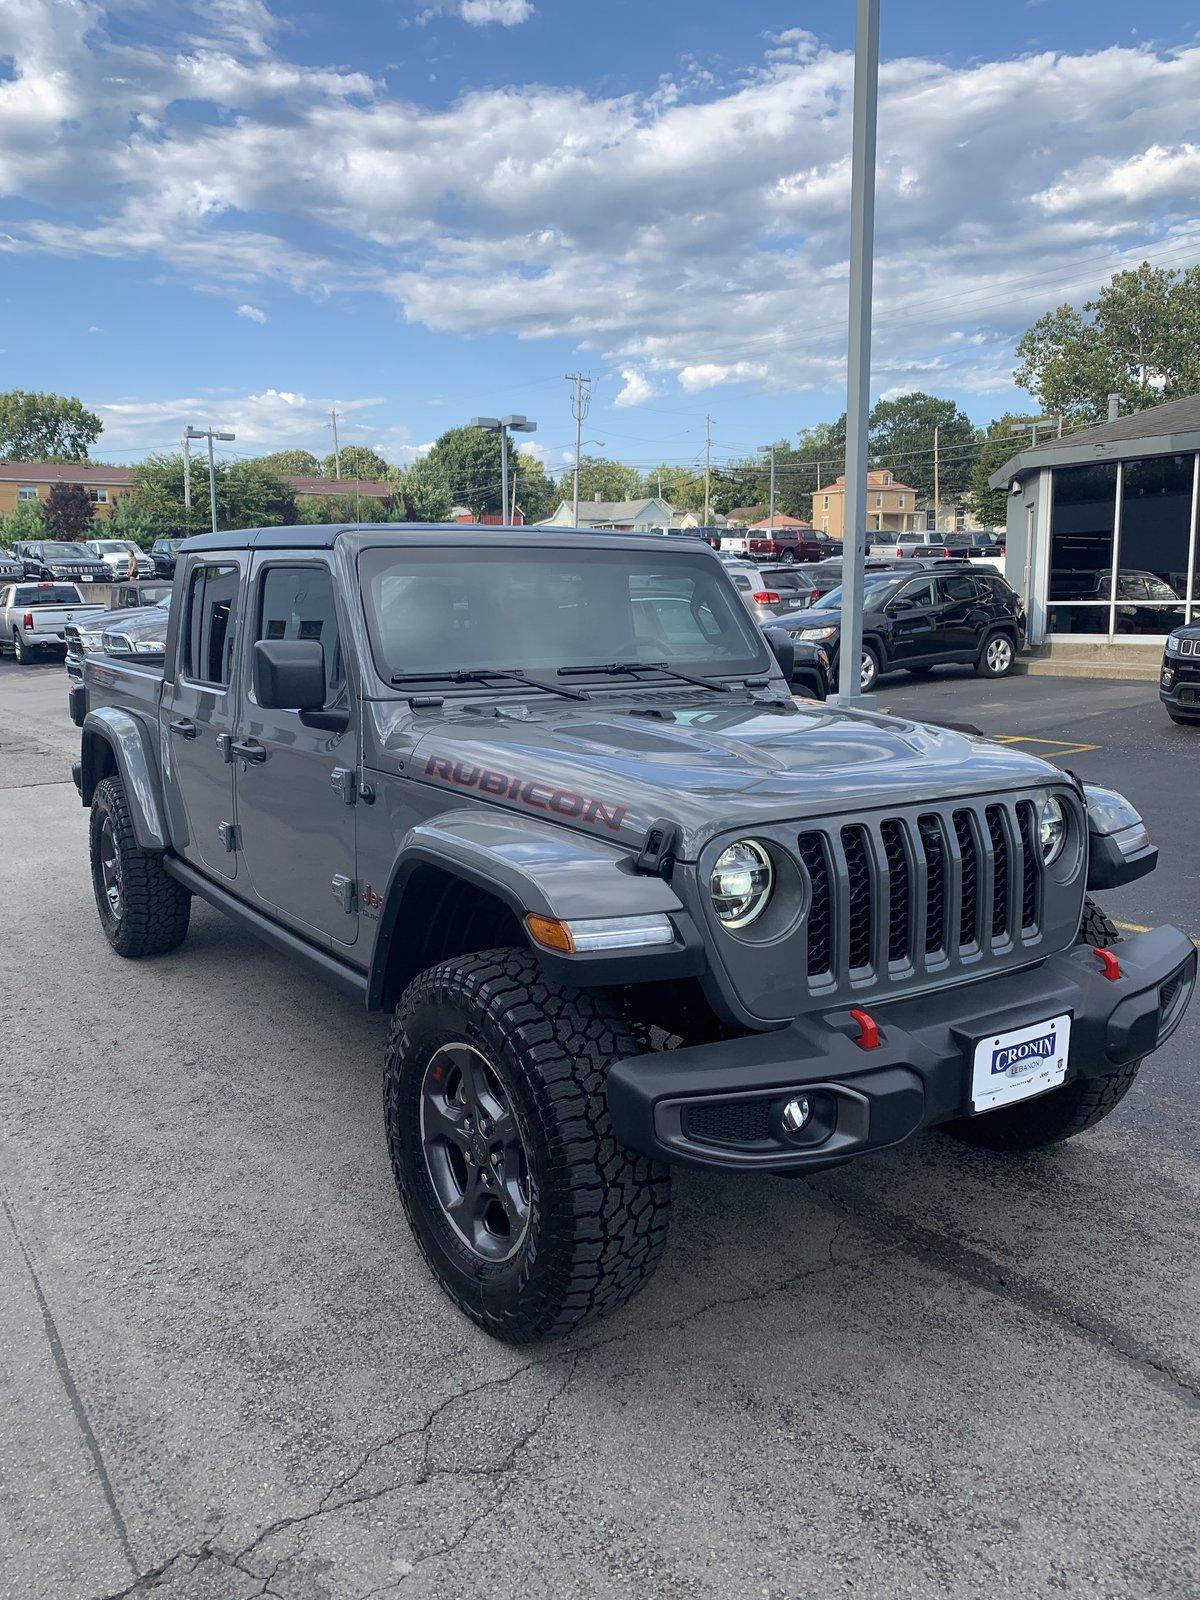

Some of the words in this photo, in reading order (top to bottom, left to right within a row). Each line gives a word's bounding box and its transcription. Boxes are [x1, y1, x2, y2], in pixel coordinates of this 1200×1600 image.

[424, 755, 628, 830] RUBICON
[995, 1036, 1054, 1071] CRONIN
[1011, 1061, 1040, 1075] LEBANON
